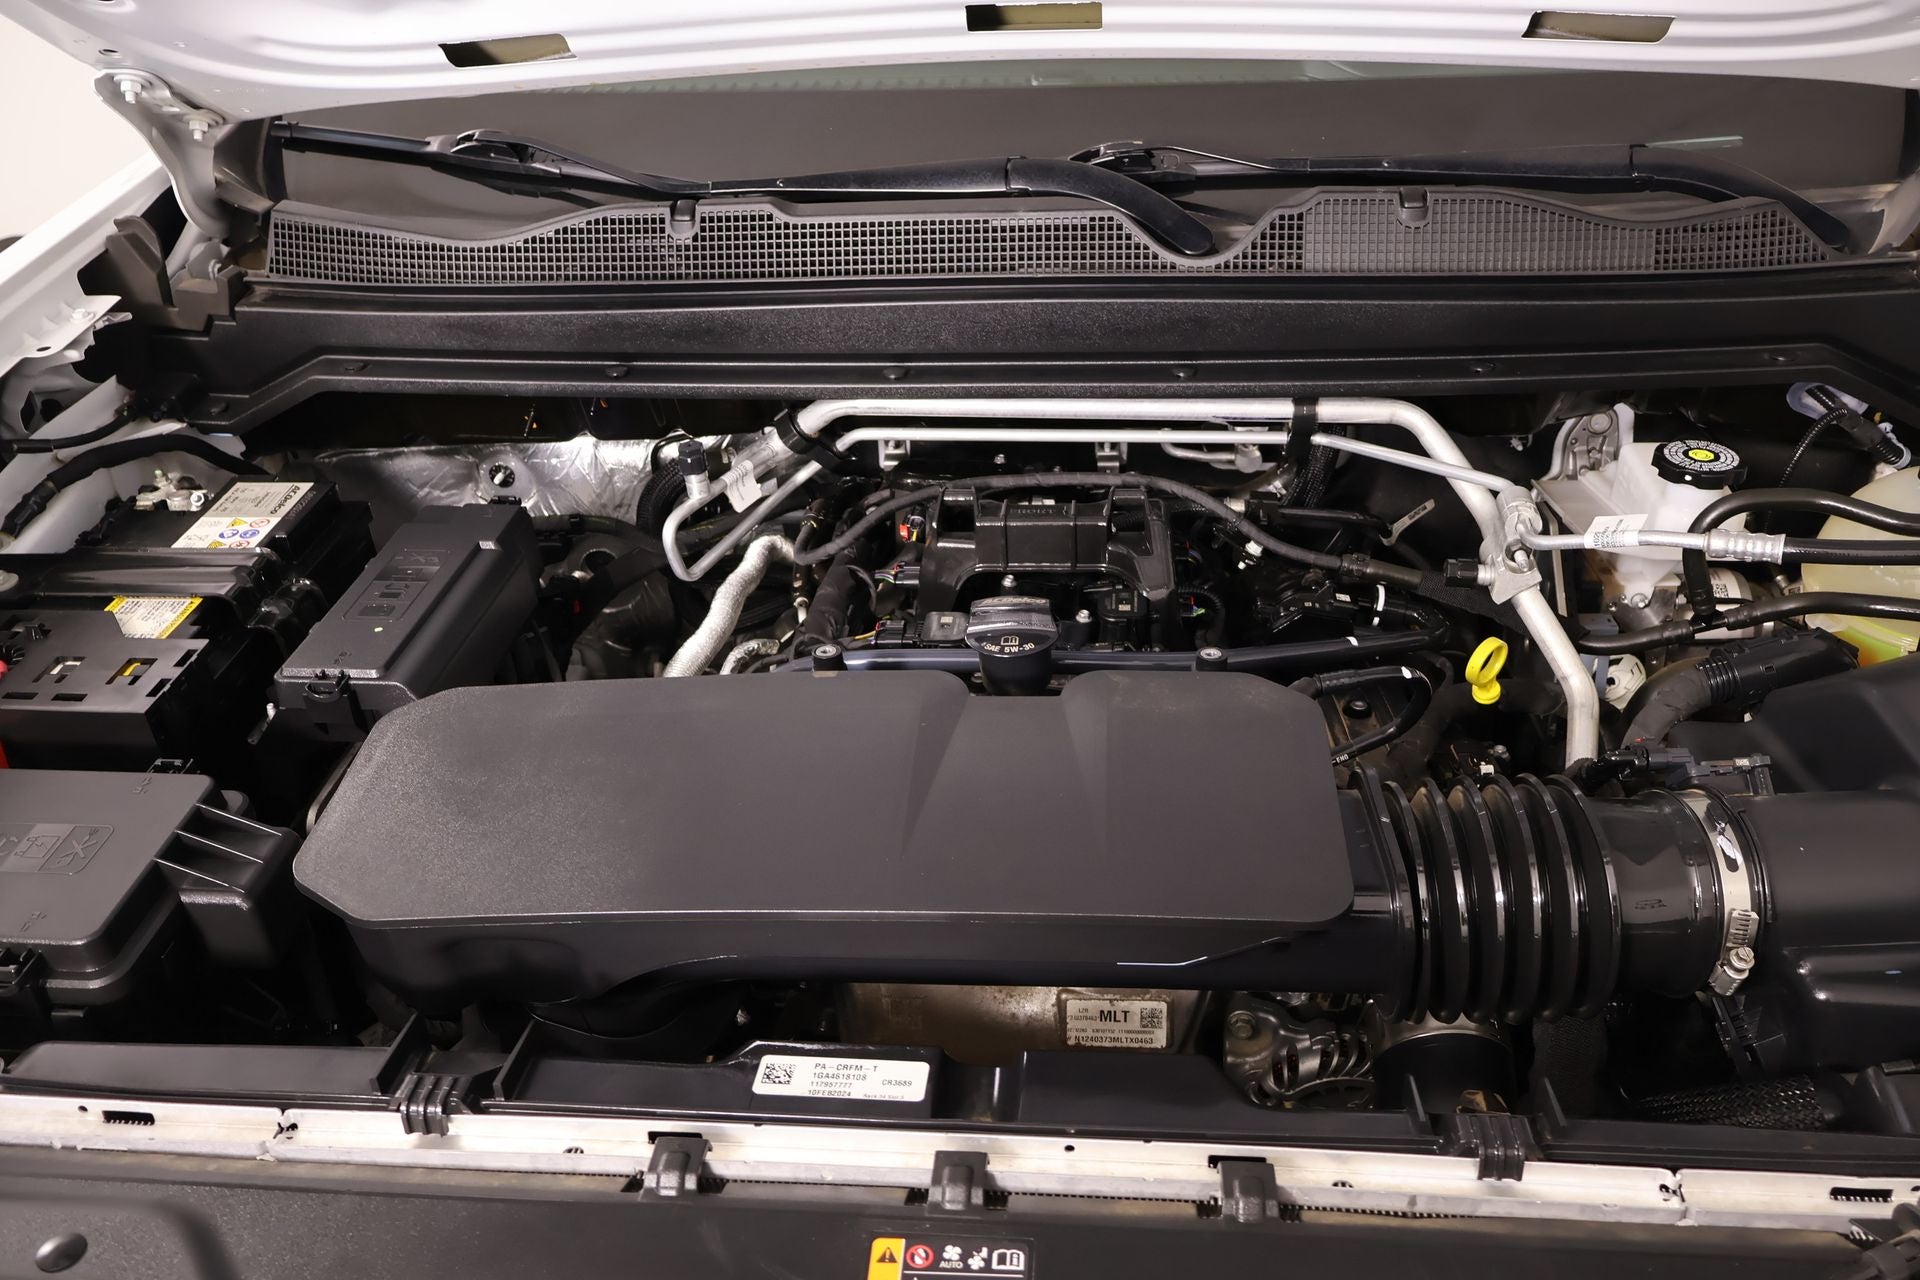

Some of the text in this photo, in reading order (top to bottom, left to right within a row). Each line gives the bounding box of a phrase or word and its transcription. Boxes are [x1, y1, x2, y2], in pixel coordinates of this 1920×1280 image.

[270, 485, 300, 514] ACDelco
[984, 643, 1035, 653] SAE 5W-30
[1099, 1010, 1130, 1023] MLT
[939, 1261, 964, 1269] AUTO
